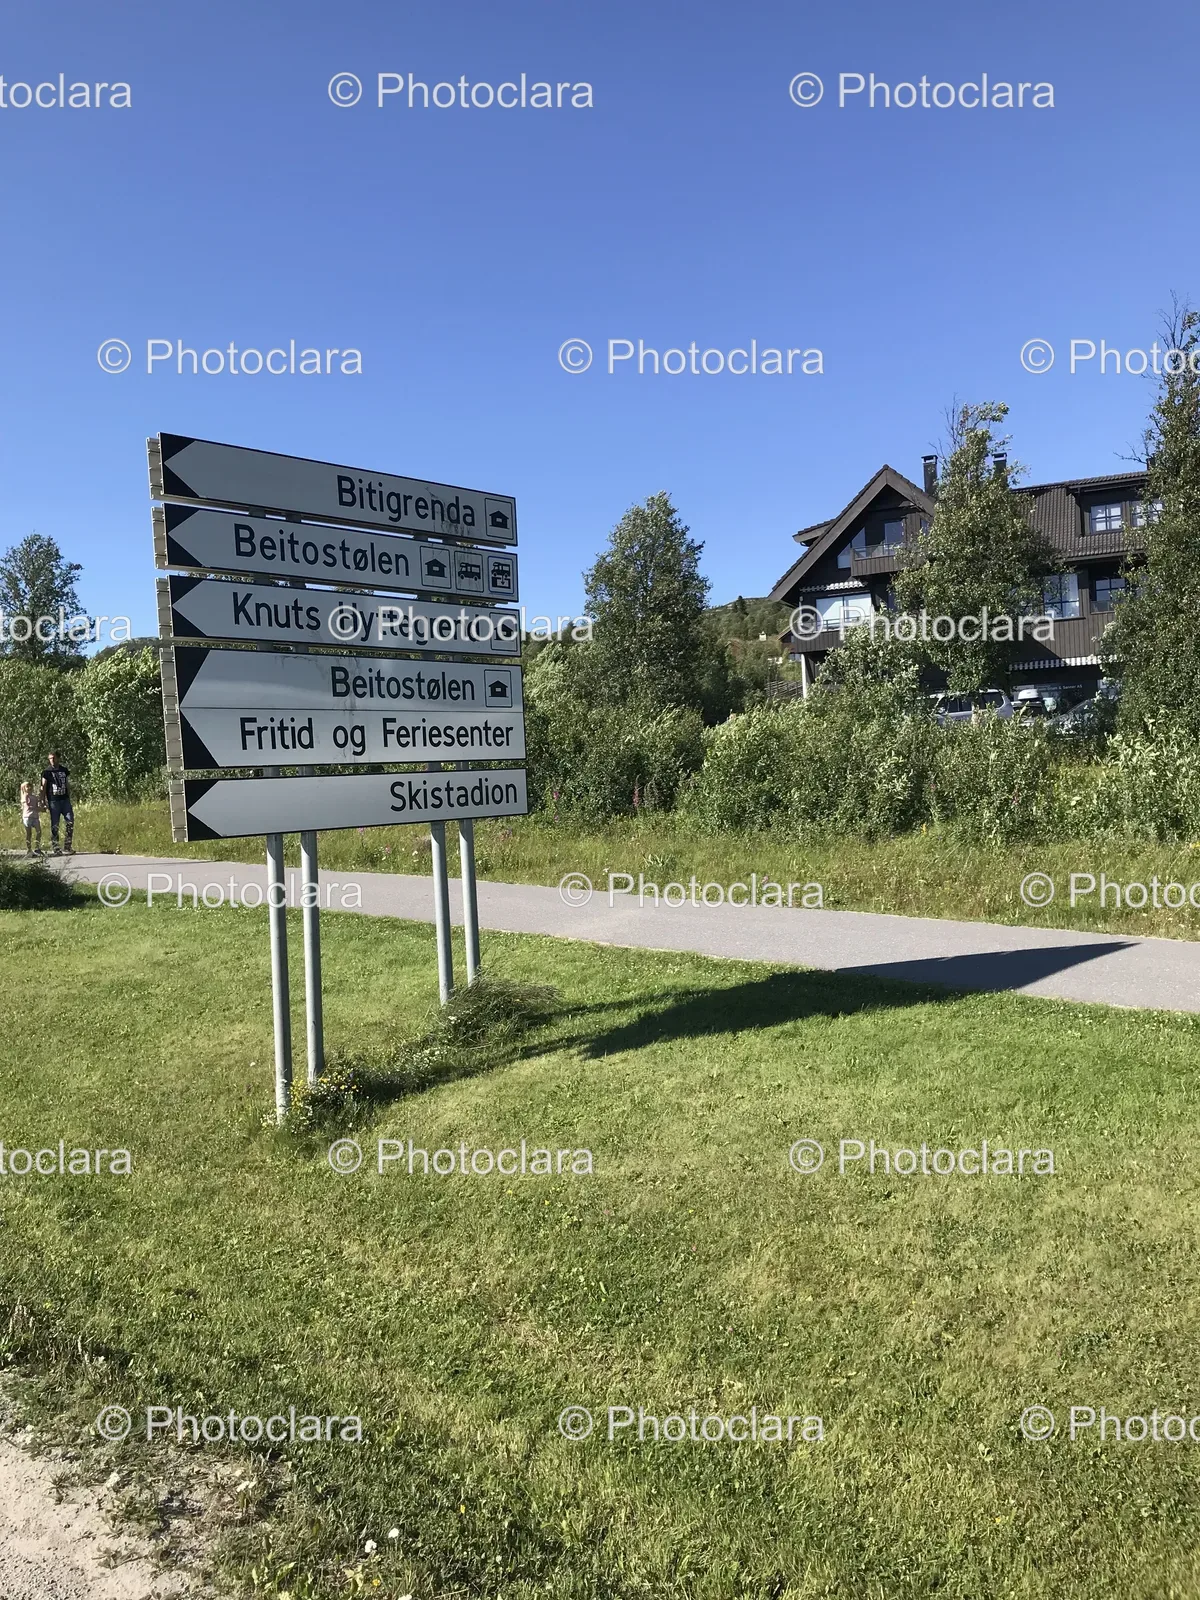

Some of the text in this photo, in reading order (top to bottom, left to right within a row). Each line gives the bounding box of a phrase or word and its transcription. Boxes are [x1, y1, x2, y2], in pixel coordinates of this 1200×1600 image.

[336, 474, 475, 527] Bitigrenda
[234, 523, 409, 576] Beitostølen
[232, 591, 321, 631] Knuts
[331, 666, 475, 702] Beitostølen
[240, 716, 513, 756] Fritid og Feriesenter
[390, 777, 518, 812] Skistadion
